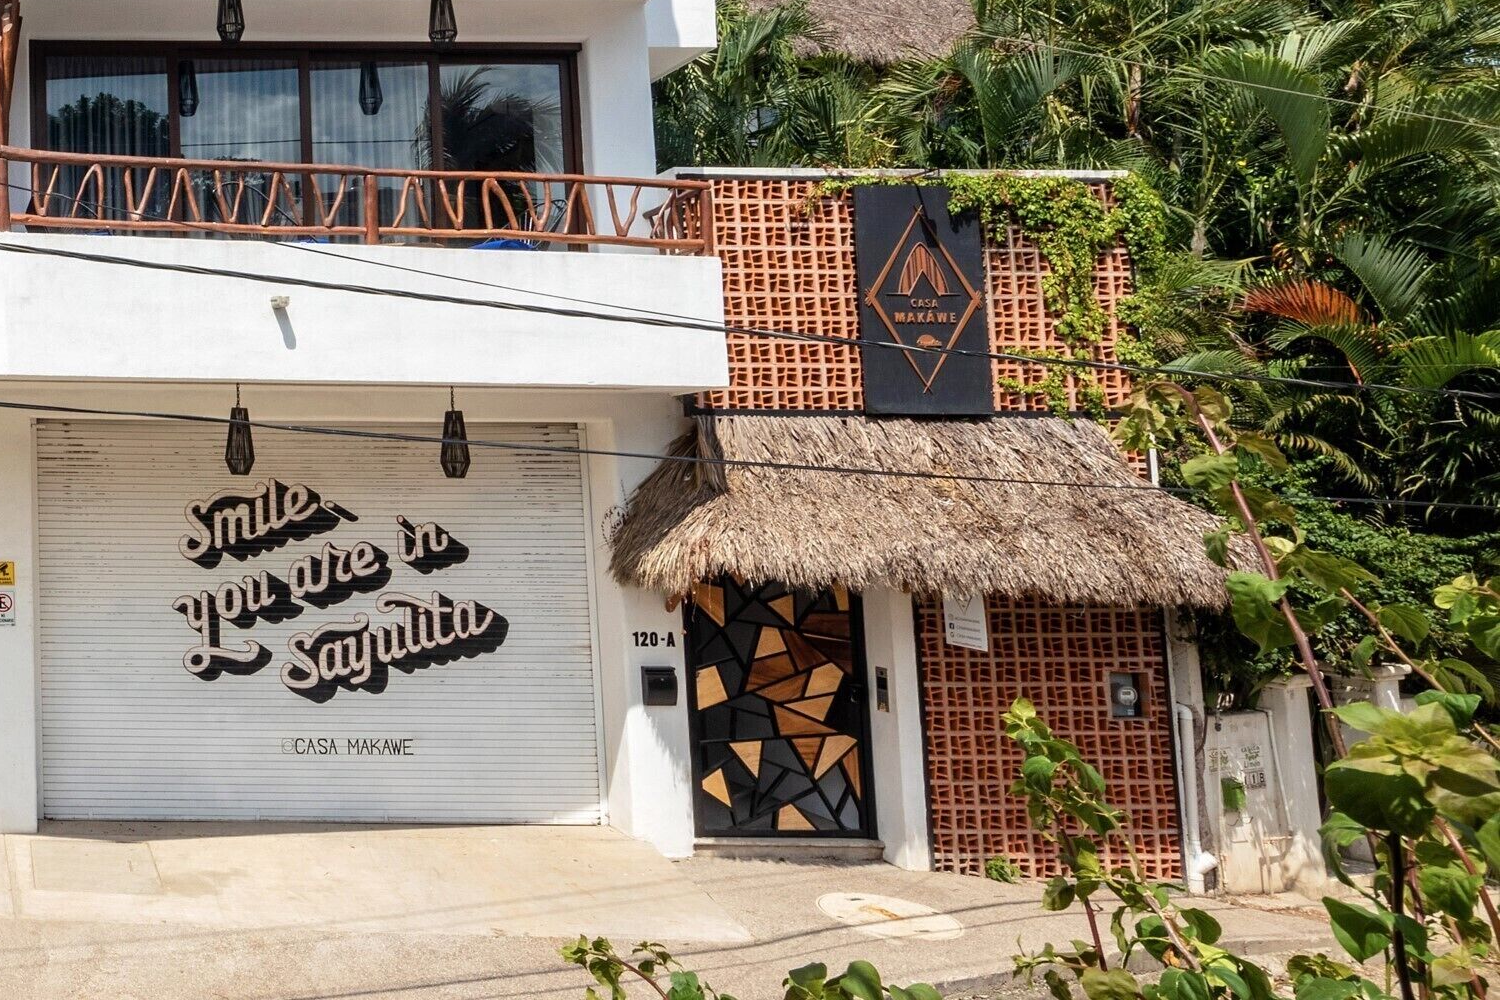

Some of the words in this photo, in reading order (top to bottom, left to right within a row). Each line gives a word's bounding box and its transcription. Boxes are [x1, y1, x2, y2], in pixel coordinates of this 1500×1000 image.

[910, 298, 939, 309] CASA
[288, 541, 392, 609] are
[396, 514, 470, 575] in
[280, 590, 509, 704] Sayulita
[632, 631, 676, 647] 120-A
[295, 738, 338, 755] CASA
[347, 738, 414, 756] MAKAWE
